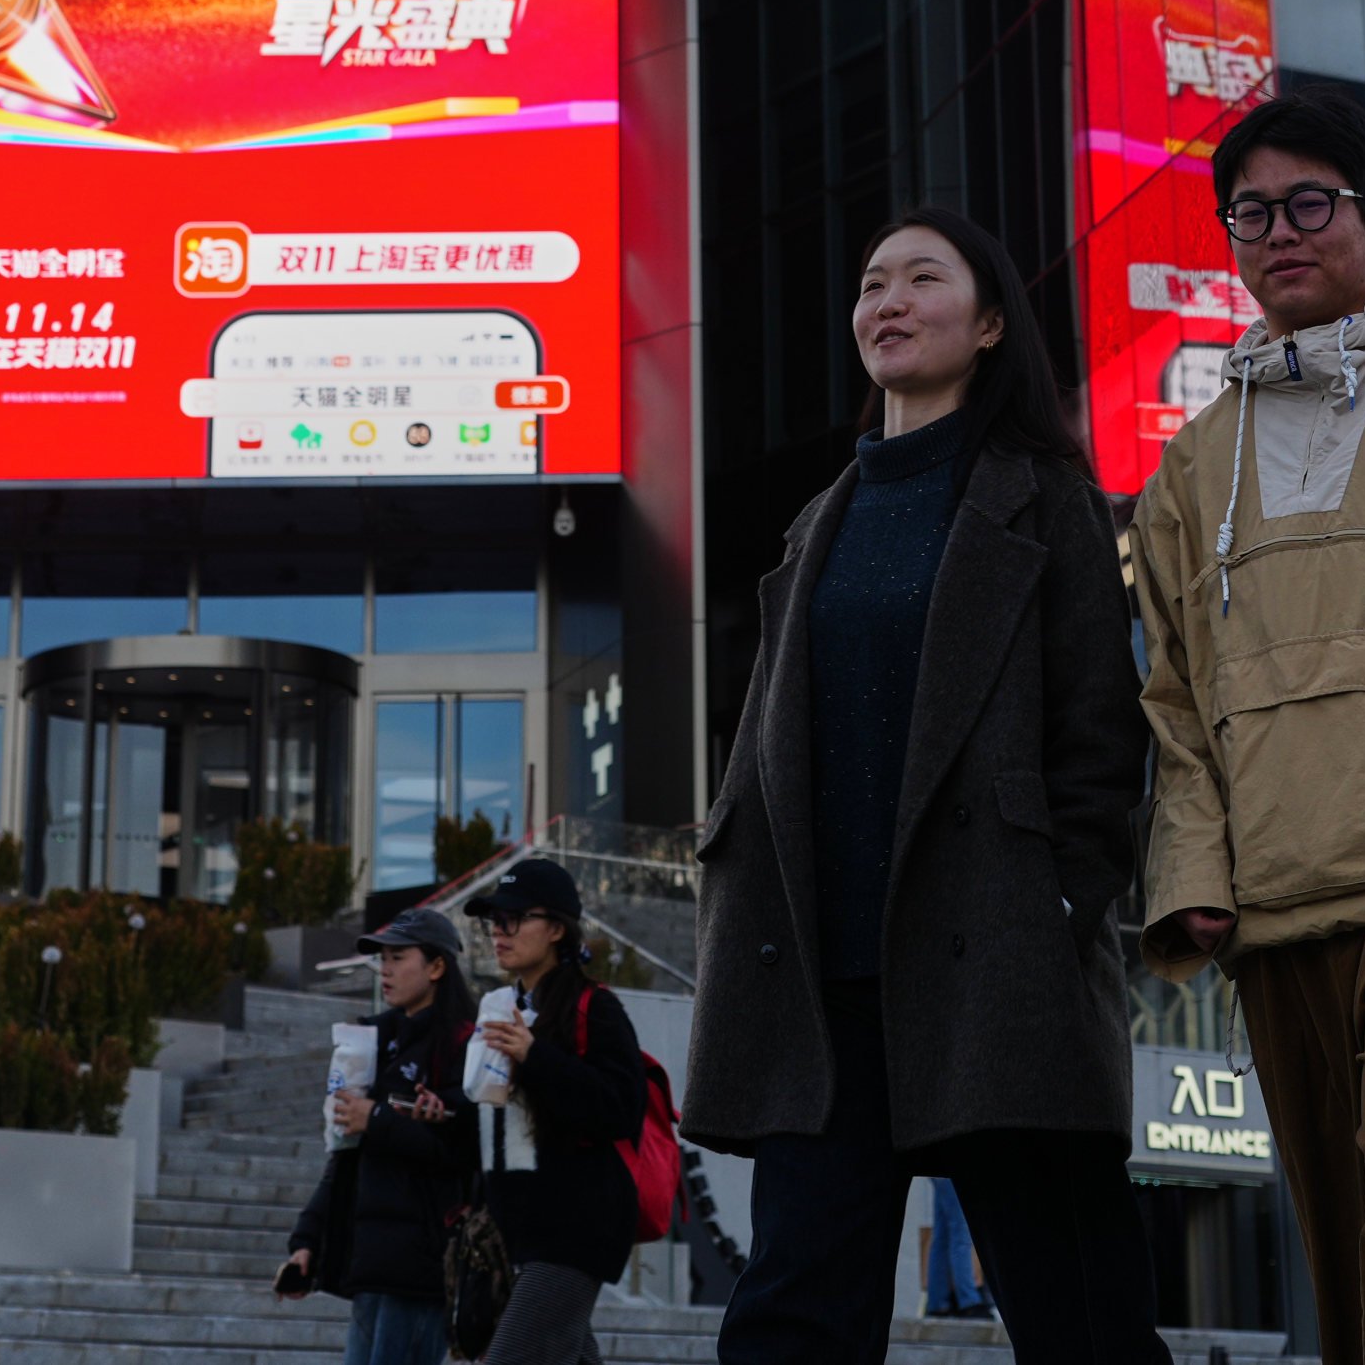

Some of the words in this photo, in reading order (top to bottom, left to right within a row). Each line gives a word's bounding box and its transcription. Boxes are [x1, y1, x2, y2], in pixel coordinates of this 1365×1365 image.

[340, 48, 385, 67] STAR
[387, 48, 438, 67] GALA
[183, 236, 244, 284] 淘
[292, 386, 413, 408] 天猫全明星
[1170, 1065, 1245, 1118] 入口
[1146, 1121, 1271, 1159] ENTRANCE
